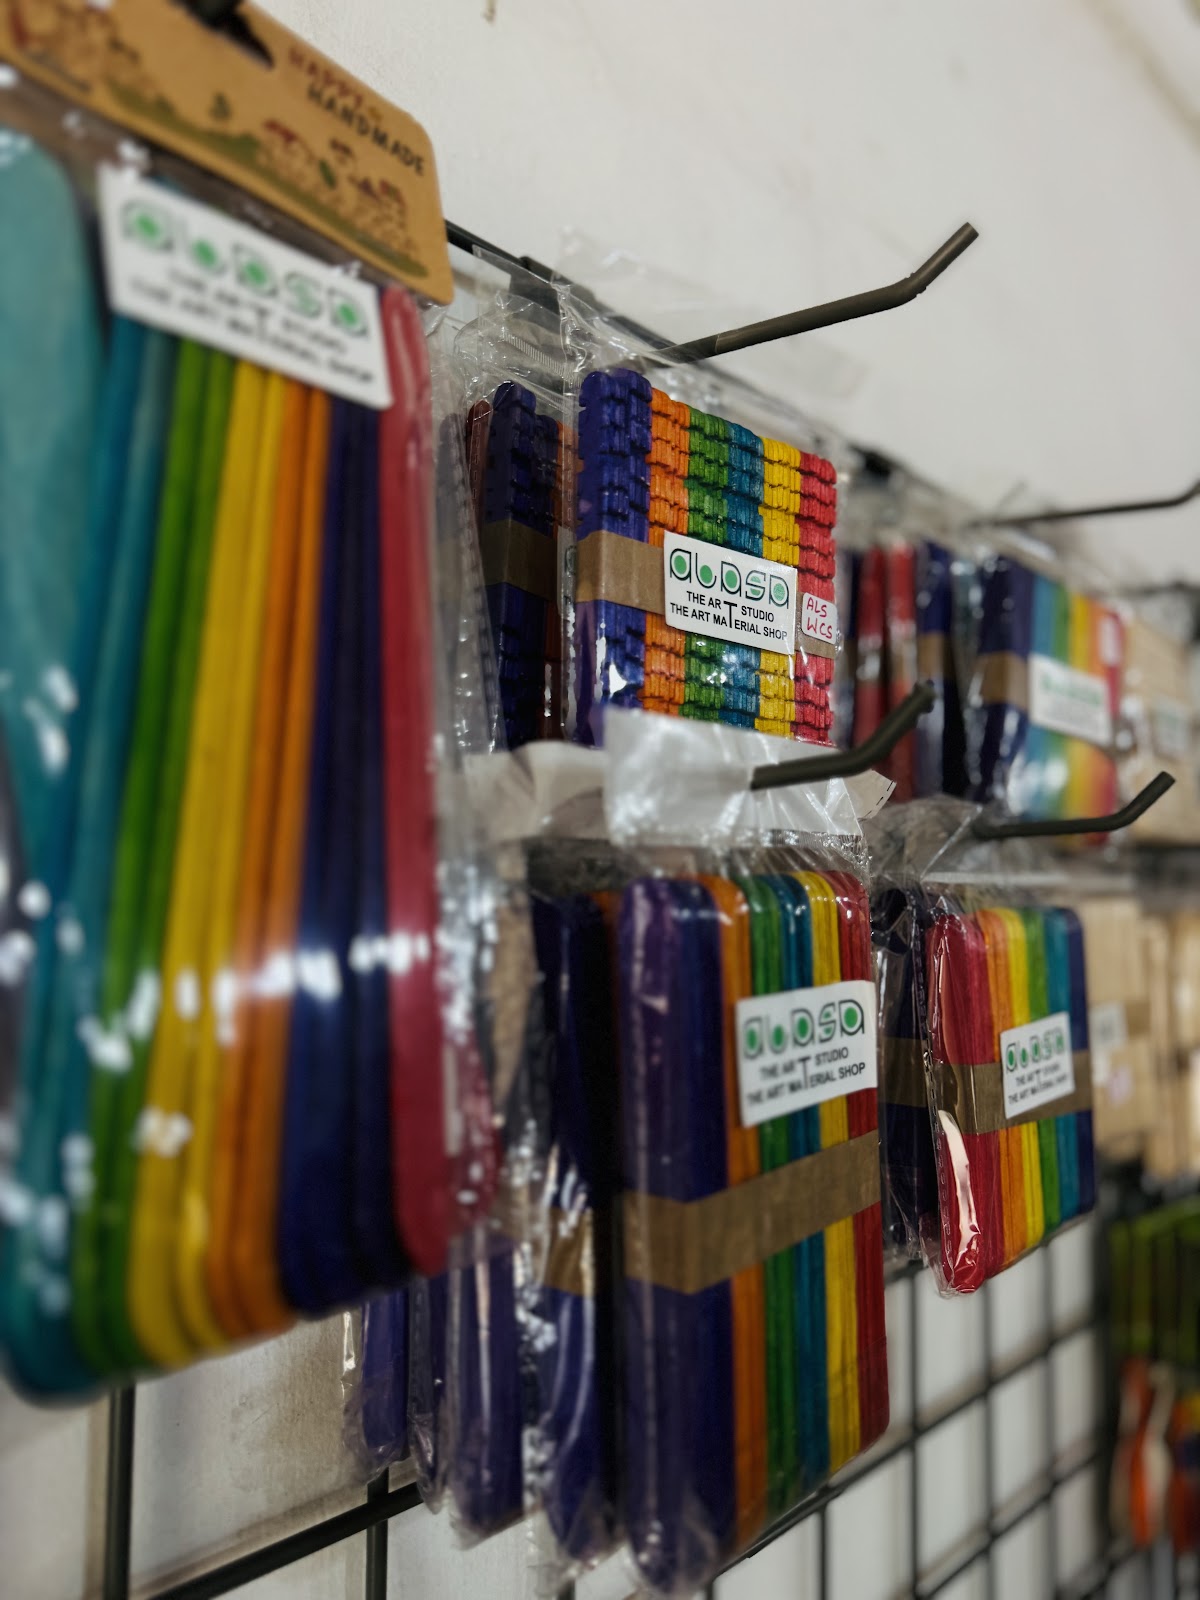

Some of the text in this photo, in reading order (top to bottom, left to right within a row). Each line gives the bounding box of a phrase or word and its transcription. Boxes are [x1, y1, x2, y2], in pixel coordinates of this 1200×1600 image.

[307, 83, 425, 176] HANDMADE
[670, 600, 788, 641] THE ART MATERIAL SHOP
[686, 590, 775, 629] THE ART STUDIO
[806, 596, 827, 618] ALS
[807, 616, 833, 639] WCS
[747, 1055, 866, 1106] THE ART MATERIAL SHOP
[760, 1046, 850, 1090] THE ART STUDIO
